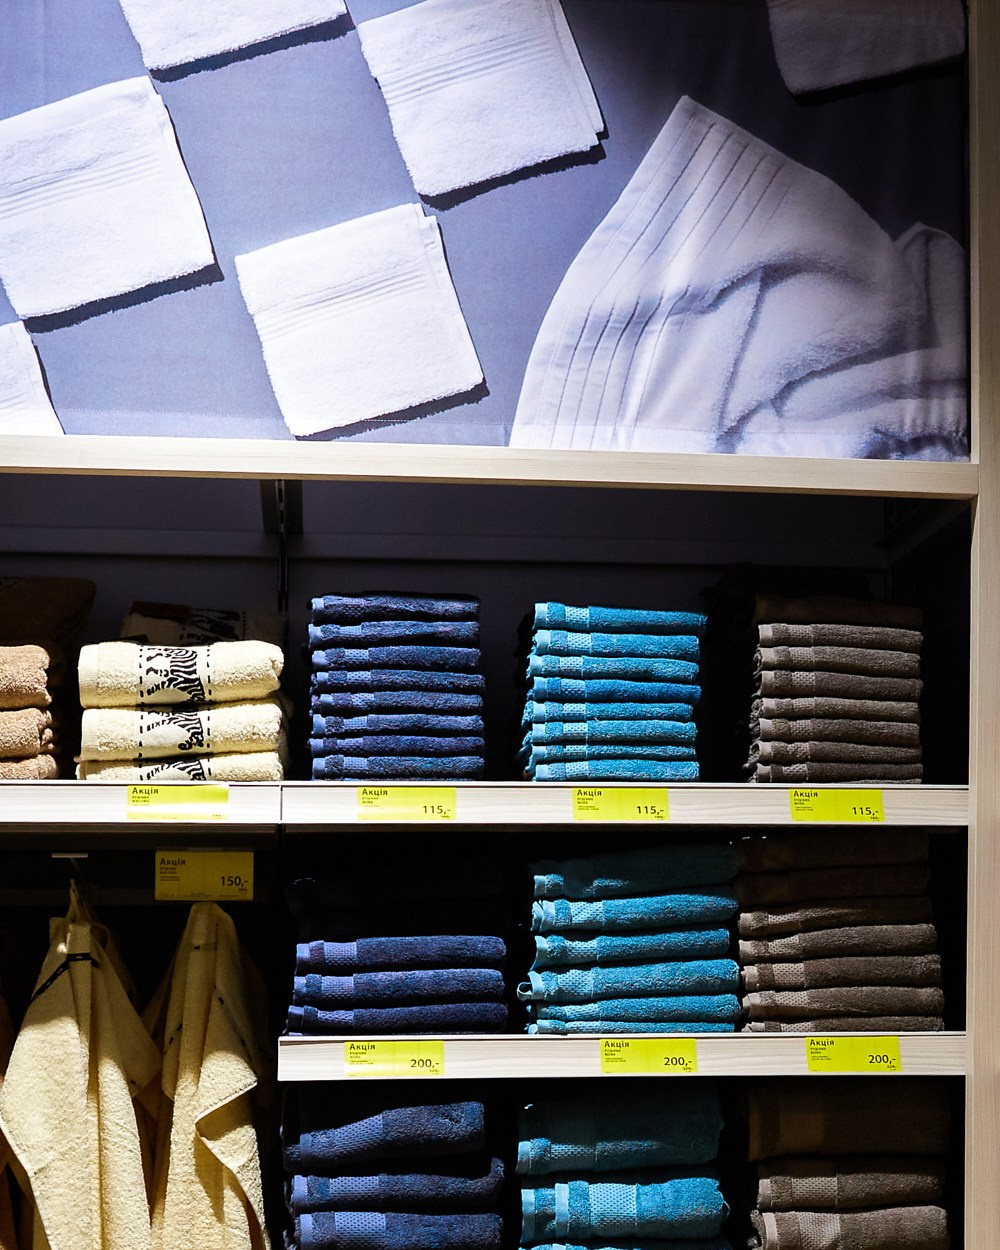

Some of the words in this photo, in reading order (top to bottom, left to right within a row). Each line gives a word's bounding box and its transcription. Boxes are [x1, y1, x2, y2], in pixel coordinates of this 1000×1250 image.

[131, 787, 159, 795] Акція
[362, 788, 388, 797] Акція
[576, 789, 602, 797] Акція
[793, 790, 818, 798] Акція
[422, 805, 451, 815] 115,-
[636, 805, 664, 816] 115,-
[852, 806, 879, 817] 115,-
[159, 858, 186, 866] Акція
[220, 876, 249, 887] 150,-
[349, 1043, 376, 1051] Акція
[604, 1040, 630, 1049] Акція
[809, 1038, 835, 1047] Акція
[410, 1058, 440, 1069] 200,-
[663, 1056, 692, 1067] 200,-
[868, 1054, 896, 1065] 200,-
